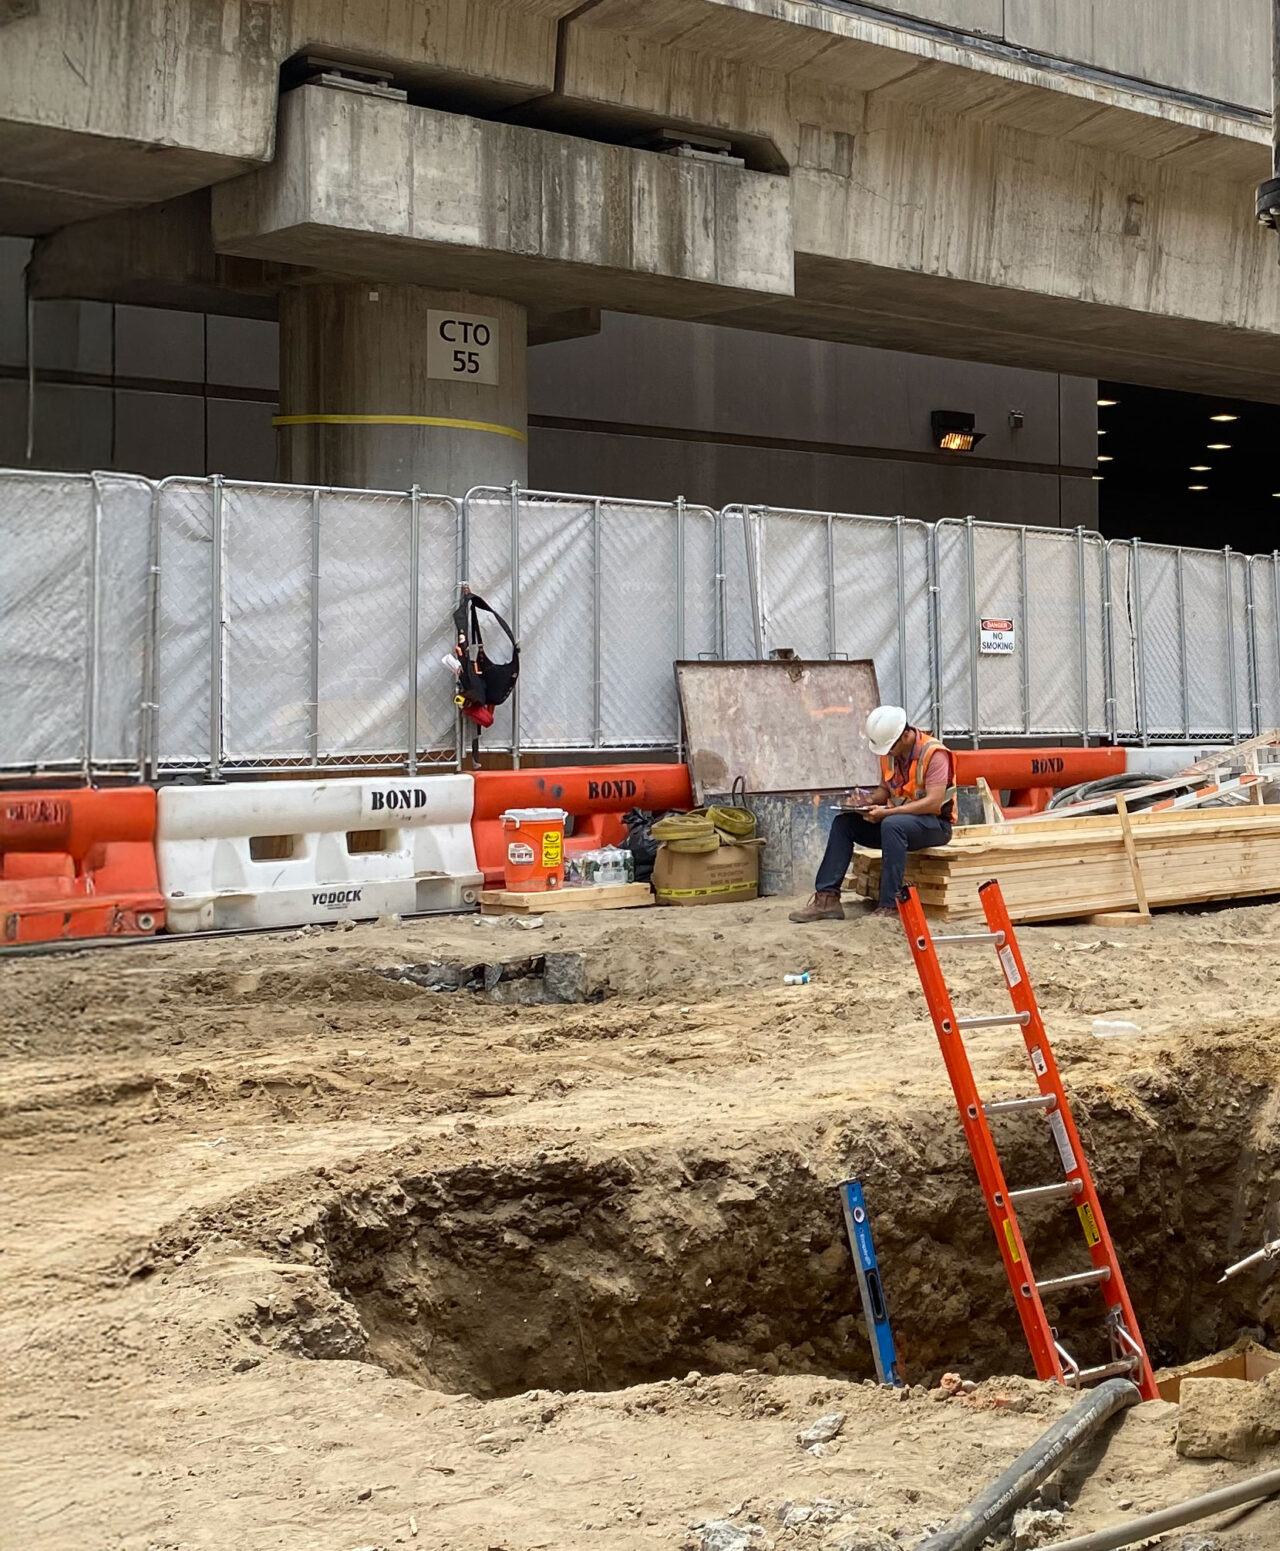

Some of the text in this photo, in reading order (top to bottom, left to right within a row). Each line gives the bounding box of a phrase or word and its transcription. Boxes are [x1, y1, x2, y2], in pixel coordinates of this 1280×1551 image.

[439, 319, 490, 346] CTO
[453, 349, 480, 374] 55
[982, 641, 1014, 651] SMOKING
[992, 632, 1003, 641] NO
[1031, 757, 1064, 775] BOND
[588, 779, 637, 800] BOND
[371, 789, 427, 810] BOND
[312, 890, 362, 905] YODOCK
